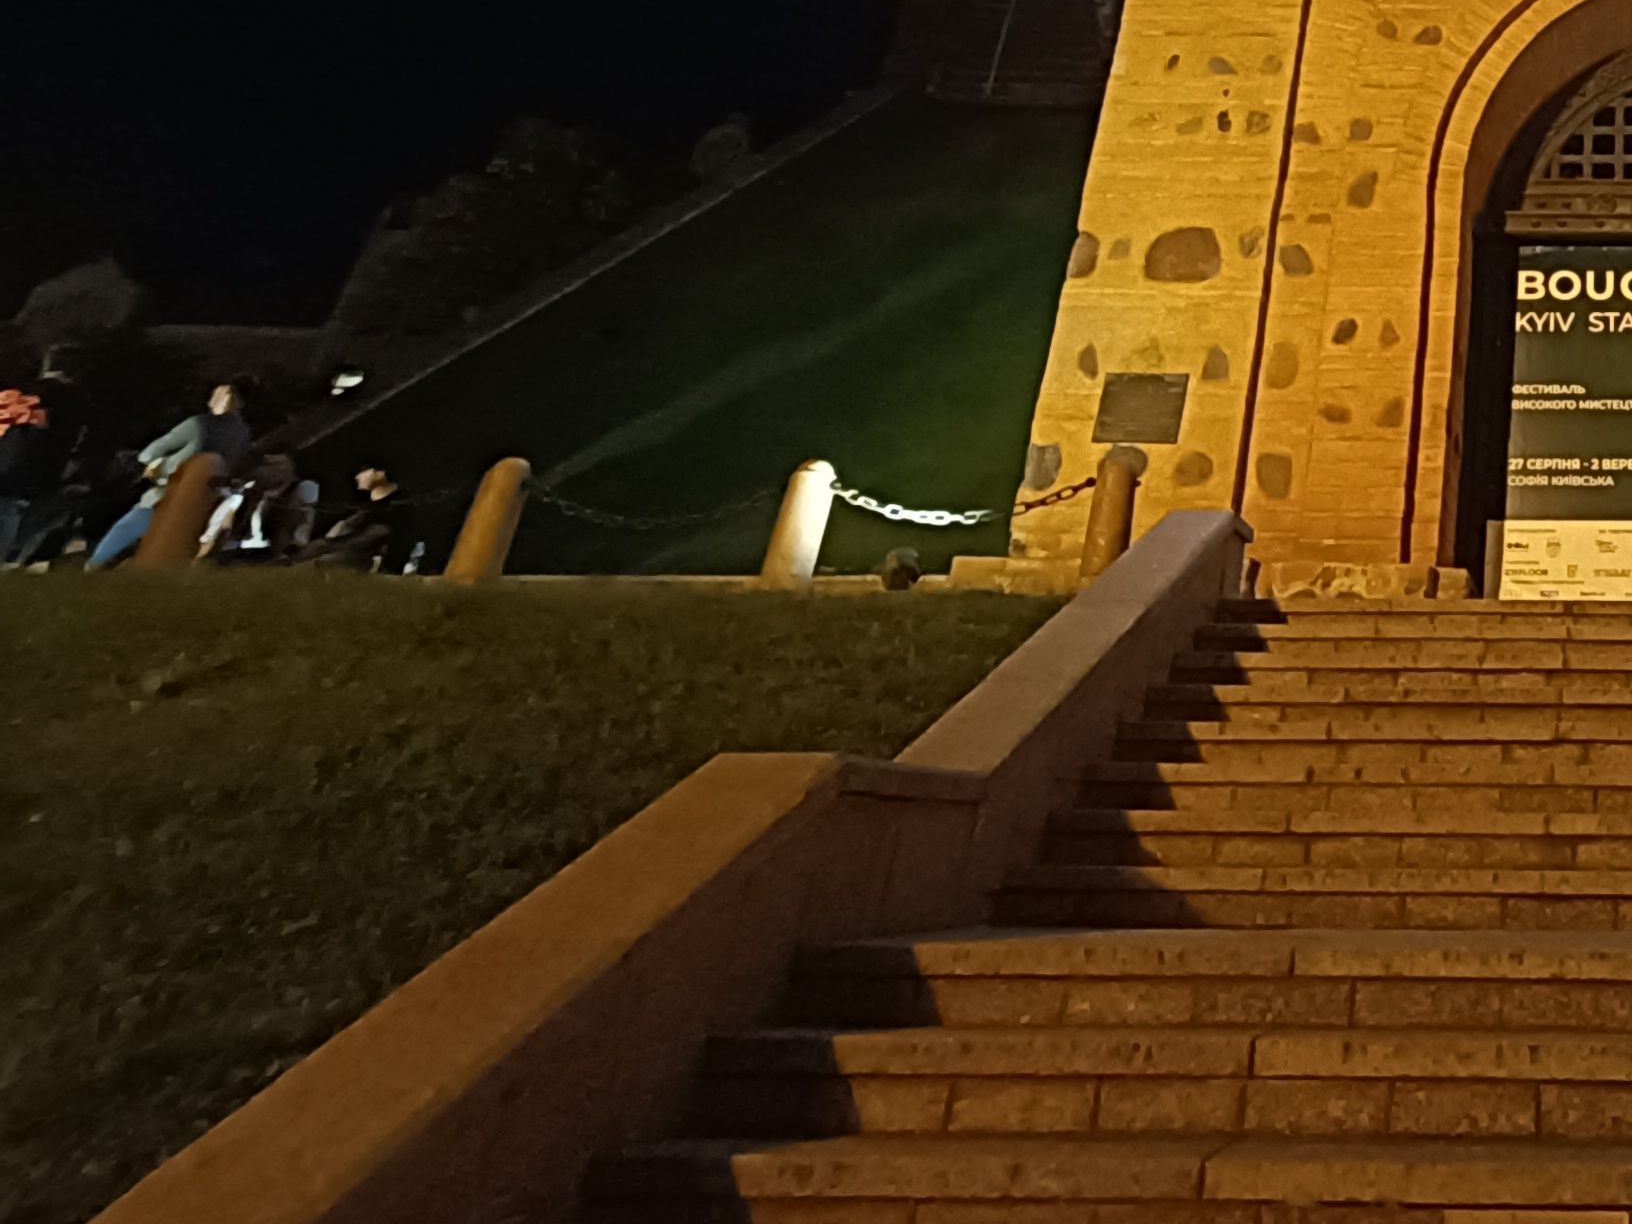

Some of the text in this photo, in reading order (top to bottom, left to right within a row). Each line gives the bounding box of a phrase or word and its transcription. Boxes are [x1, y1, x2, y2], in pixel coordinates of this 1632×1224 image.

[1515, 312, 1575, 332] KYIV
[1512, 384, 1586, 394] ФЕСТИВАЛЬ
[1512, 399, 1577, 410] ВИСОКОГО
[1508, 458, 1524, 470] 27
[1526, 458, 1581, 470] СЕРПНЯ
[1590, 458, 1600, 470] 2
[1508, 474, 1614, 486] СОФІЯ КИЇВСЬКА
